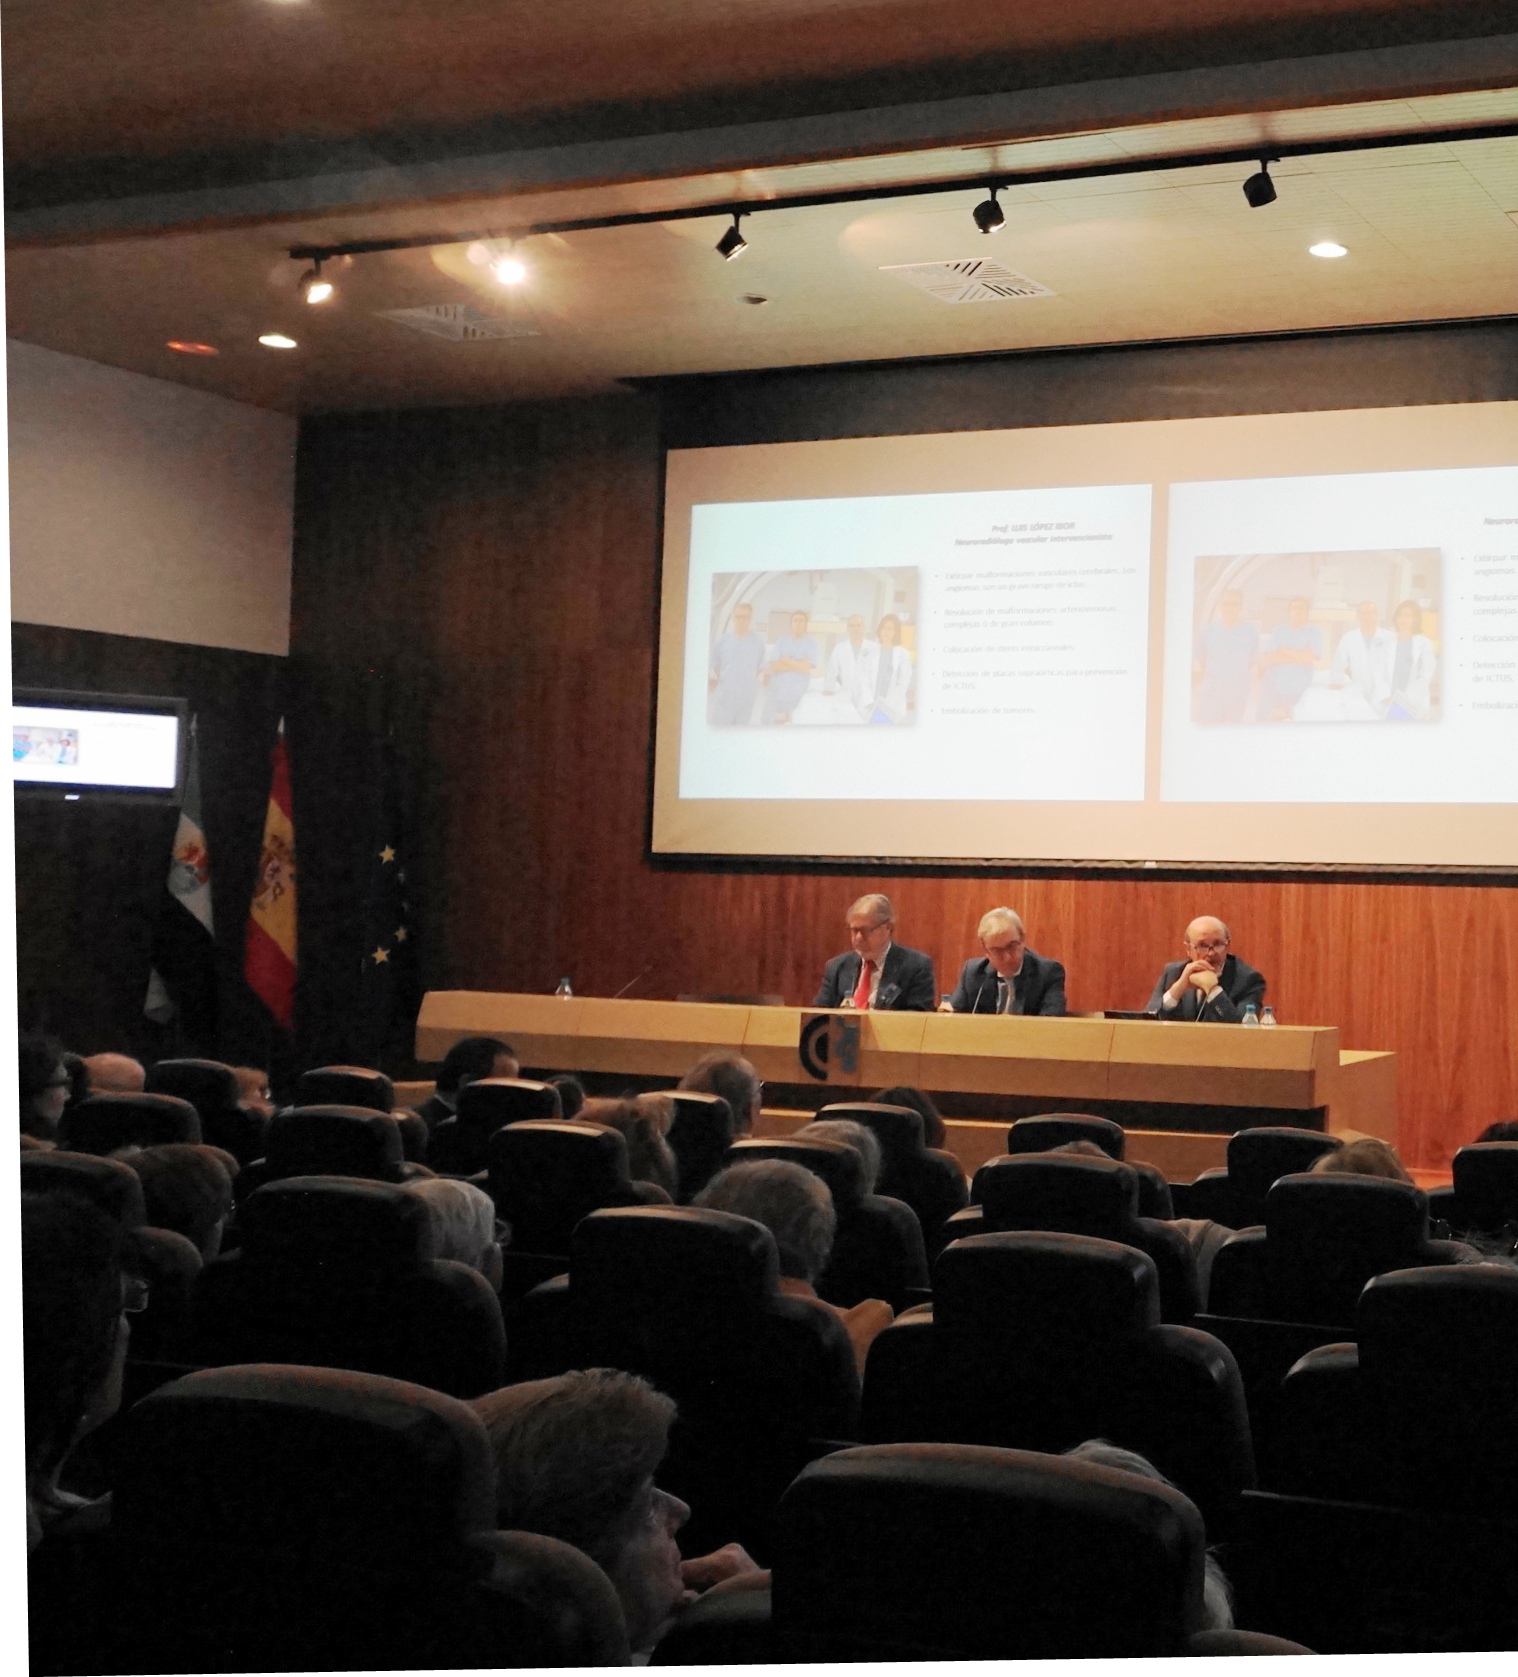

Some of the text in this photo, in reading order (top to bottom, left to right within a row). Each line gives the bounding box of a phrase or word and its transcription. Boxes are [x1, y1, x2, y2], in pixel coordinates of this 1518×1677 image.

[992, 525, 1009, 533] Prof.
[1016, 536, 1048, 544] vascular
[1050, 534, 1113, 542] intervencionista
[1474, 554, 1507, 564] Extirpar
[1472, 660, 1515, 669] Detección
